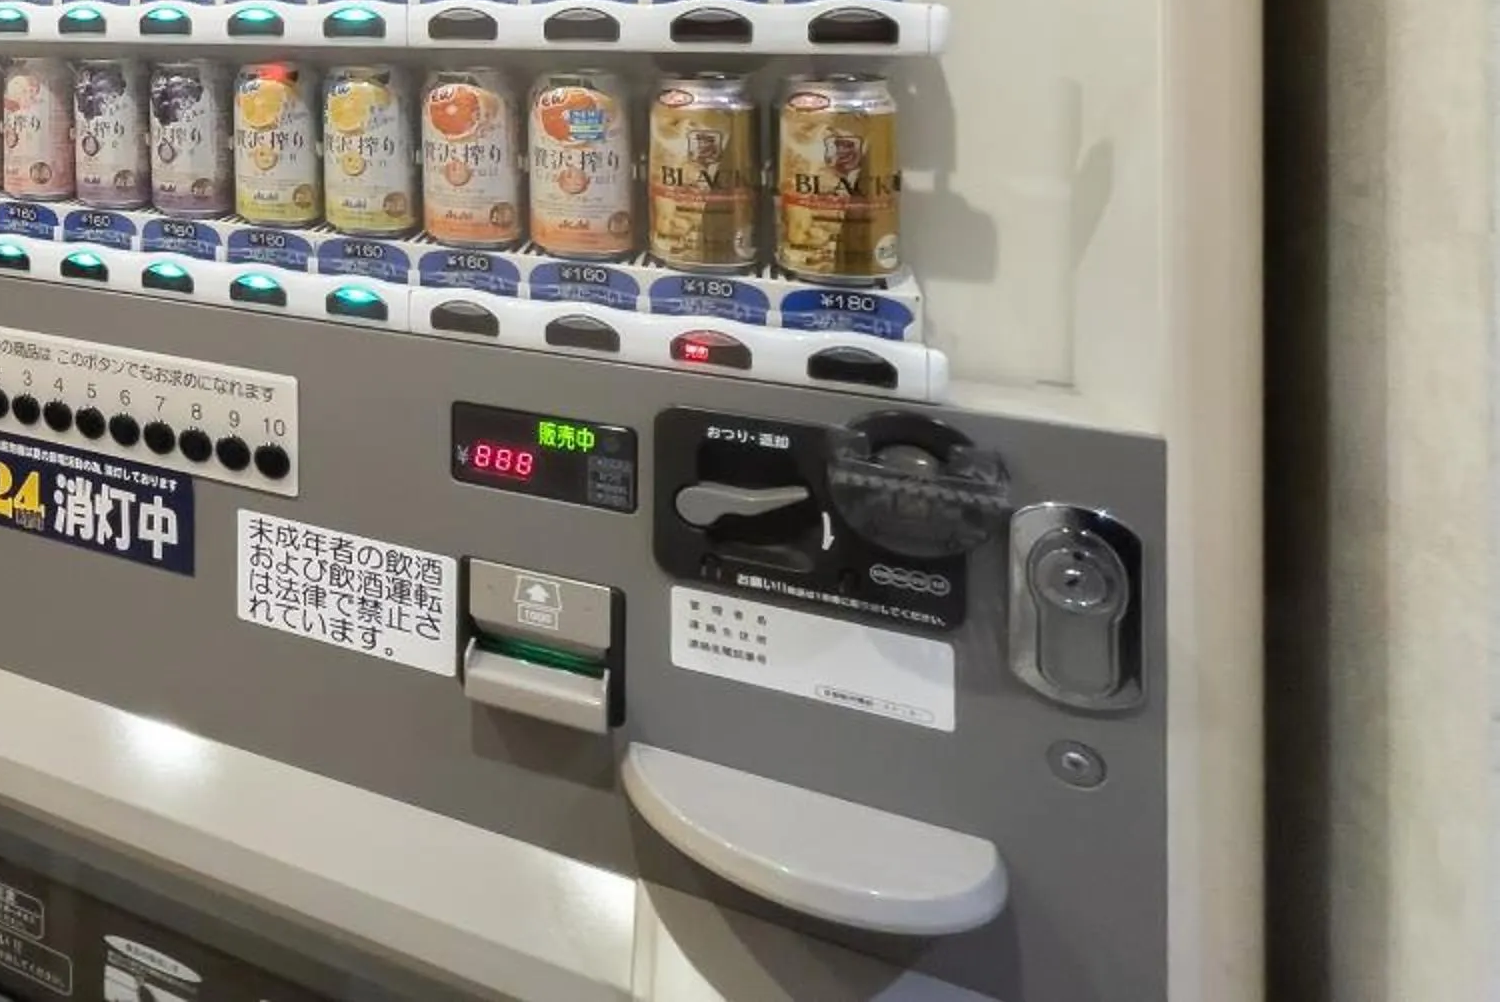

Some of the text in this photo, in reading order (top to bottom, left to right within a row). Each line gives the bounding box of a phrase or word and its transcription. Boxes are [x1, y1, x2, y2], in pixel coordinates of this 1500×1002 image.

[683, 279, 733, 297] ¥180
[820, 293, 876, 311] ¥180
[23, 369, 33, 386] 3
[53, 377, 64, 392] 4
[87, 383, 97, 398] 5
[119, 389, 131, 406] 6
[155, 396, 166, 412] 7
[191, 403, 202, 421] 8
[229, 410, 241, 428] 9
[263, 417, 286, 438] 10
[539, 421, 595, 453] 販売中
[53, 473, 179, 561] 消灯中
[249, 517, 443, 587] 未成年者の飲酒
[249, 544, 443, 615] および飲酒運転
[249, 569, 442, 641] は法律で禁止さ
[249, 595, 395, 658] れています。
